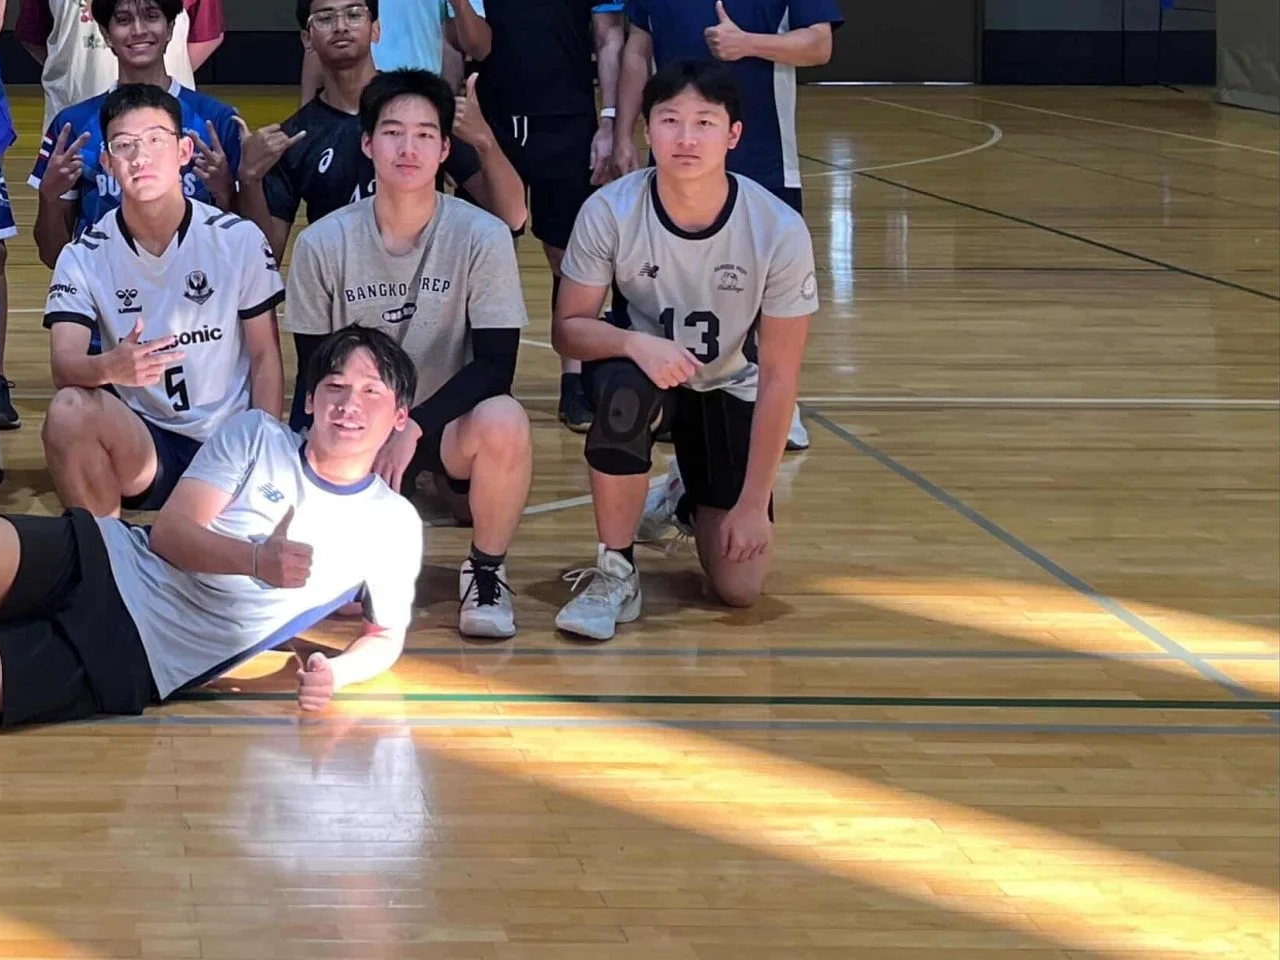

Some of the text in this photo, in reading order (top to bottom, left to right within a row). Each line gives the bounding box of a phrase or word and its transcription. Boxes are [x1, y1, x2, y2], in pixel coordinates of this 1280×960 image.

[345, 277, 451, 302] BANGKO REP
[659, 307, 720, 364] 13
[164, 366, 191, 412] 5
